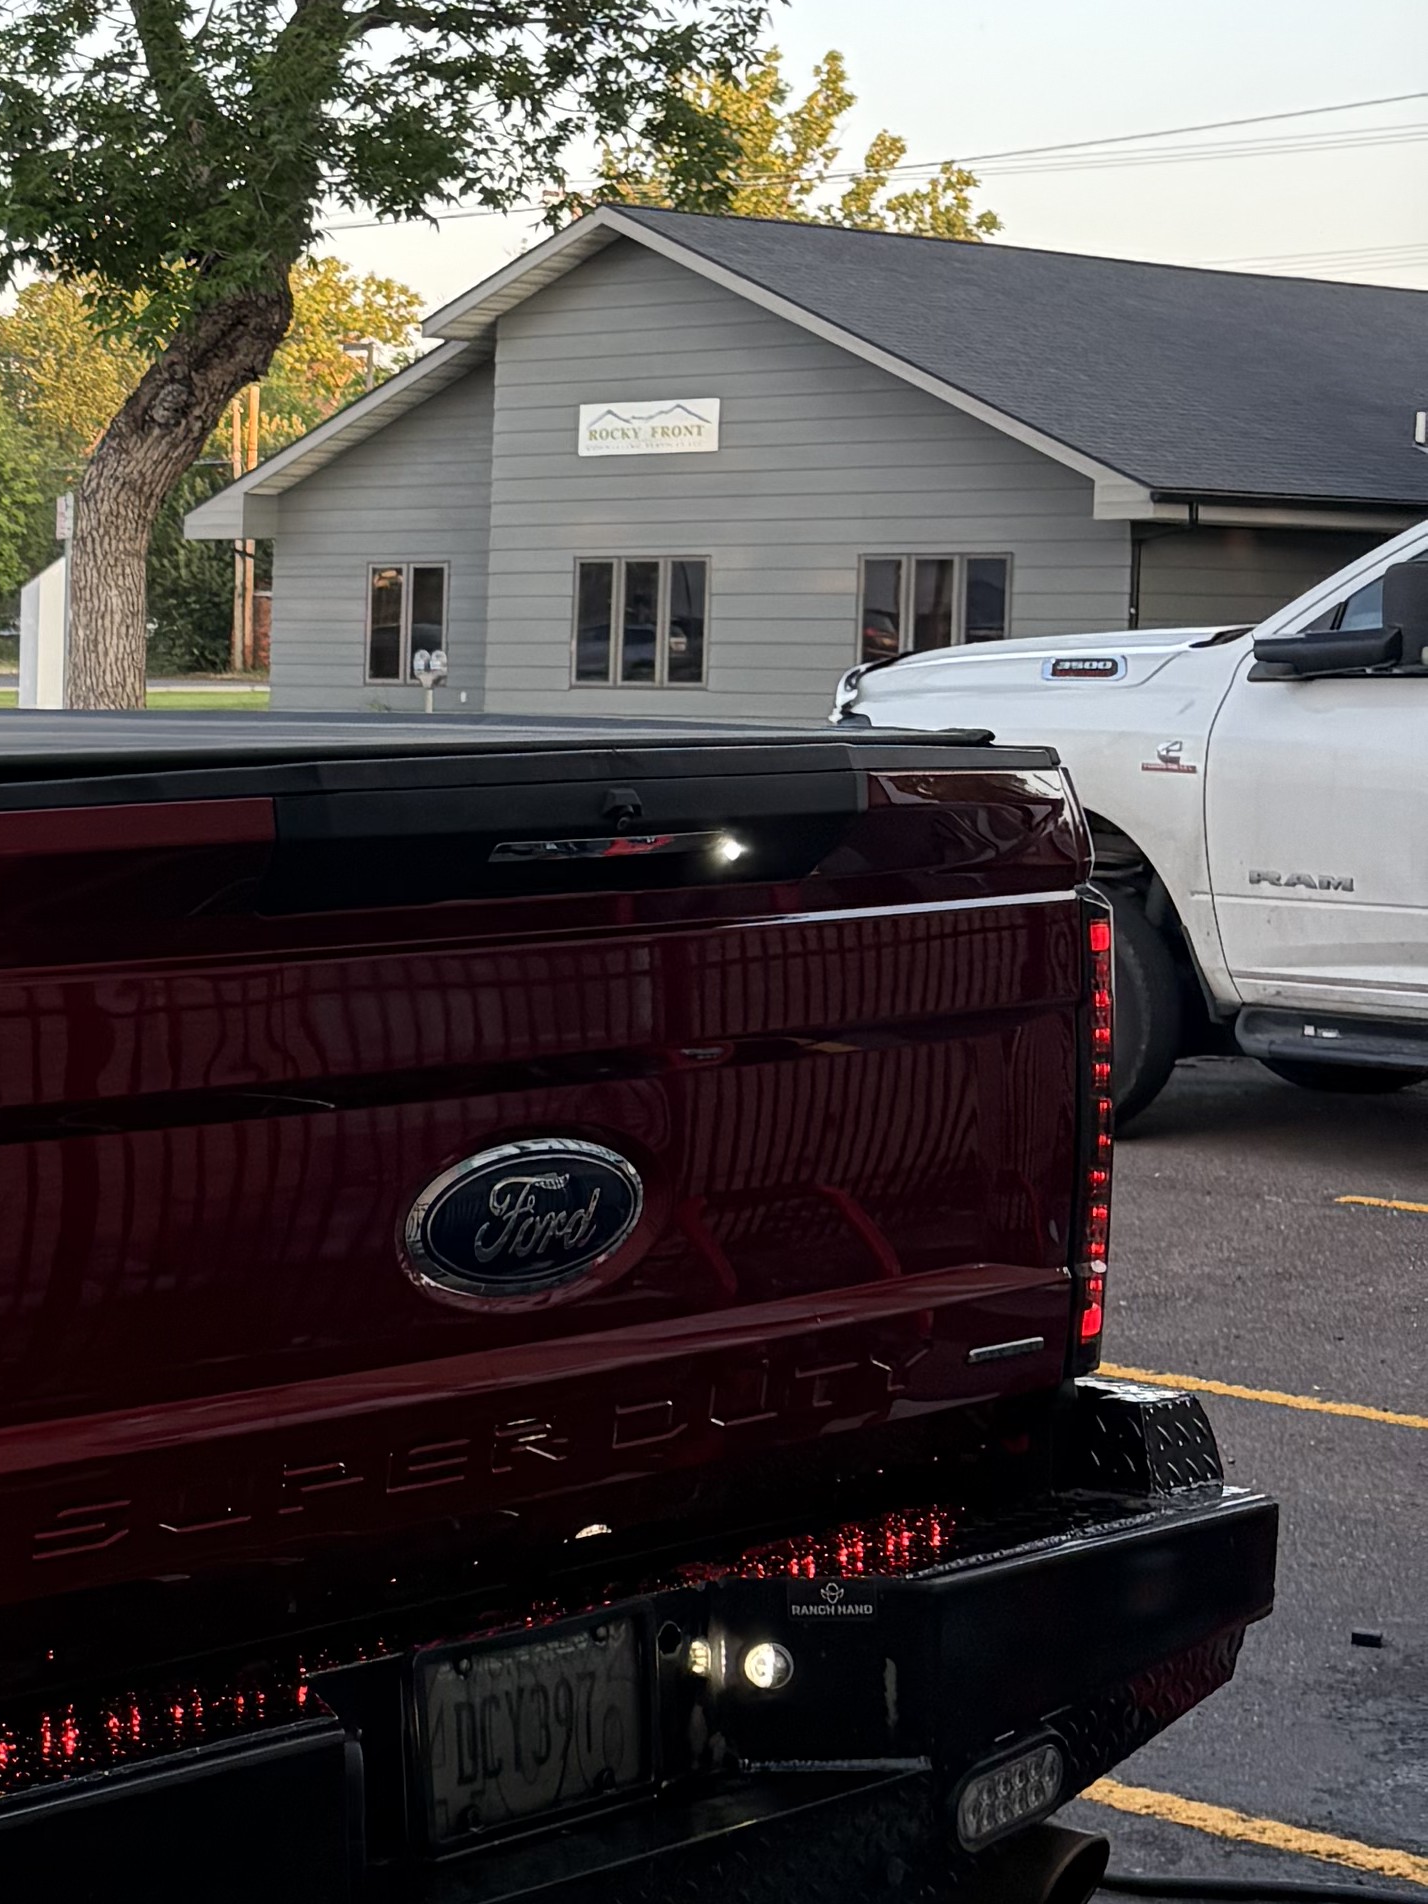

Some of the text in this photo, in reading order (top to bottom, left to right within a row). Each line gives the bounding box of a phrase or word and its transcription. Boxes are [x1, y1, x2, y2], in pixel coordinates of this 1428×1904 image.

[588, 424, 705, 441] ROCKY FRONT
[1248, 869, 1355, 893] RAM
[473, 1171, 601, 1264] Ford
[31, 1342, 934, 1561] SUPER DUTY
[791, 1604, 874, 1616] RANCH HAND
